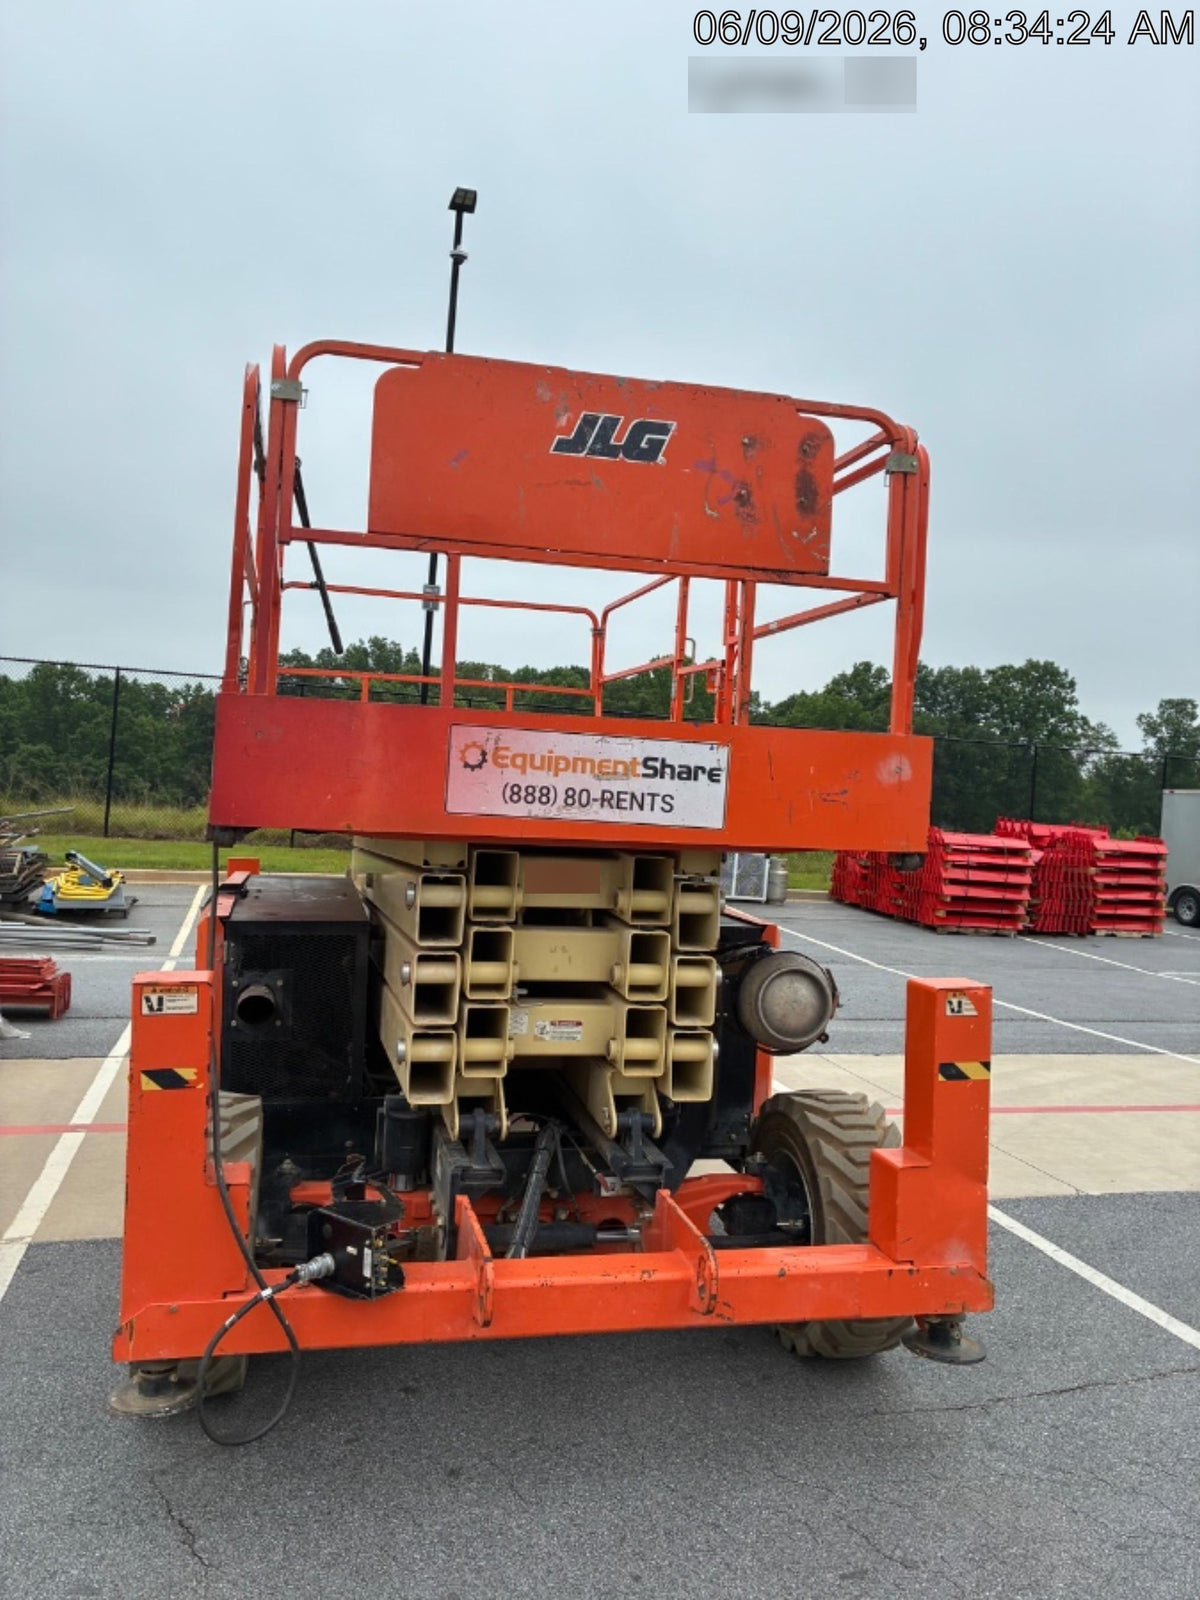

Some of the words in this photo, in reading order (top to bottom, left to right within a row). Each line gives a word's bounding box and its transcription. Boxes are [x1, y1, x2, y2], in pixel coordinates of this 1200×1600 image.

[550, 411, 677, 464] JLG
[491, 747, 722, 783] EquipmentShare
[502, 783, 558, 806] (888)
[563, 787, 674, 813] 80-RENTS
